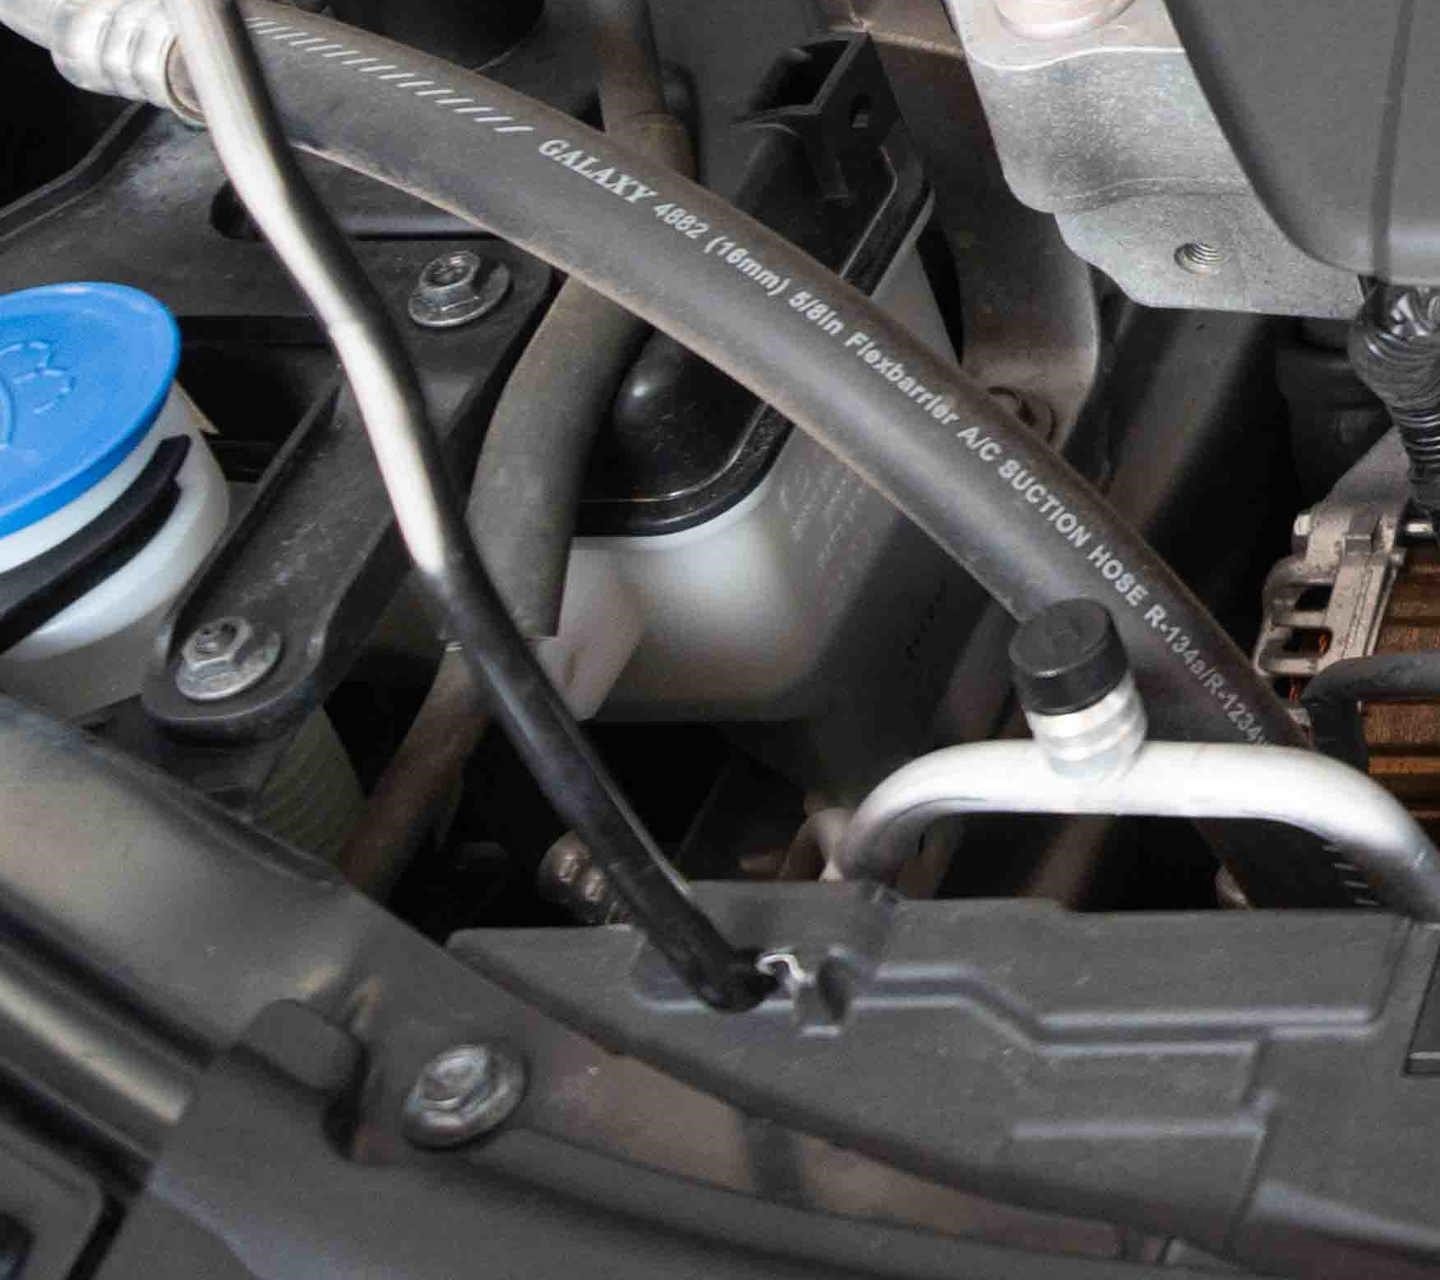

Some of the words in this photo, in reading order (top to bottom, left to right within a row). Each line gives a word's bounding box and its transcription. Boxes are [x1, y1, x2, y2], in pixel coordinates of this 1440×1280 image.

[538, 139, 657, 203] GALAXY
[703, 226, 791, 297] (16mm)
[844, 331, 960, 426] Flexbarrier
[956, 426, 1002, 462] A/C
[999, 457, 1092, 548] SUCTION
[1086, 544, 1149, 607] HOSE
